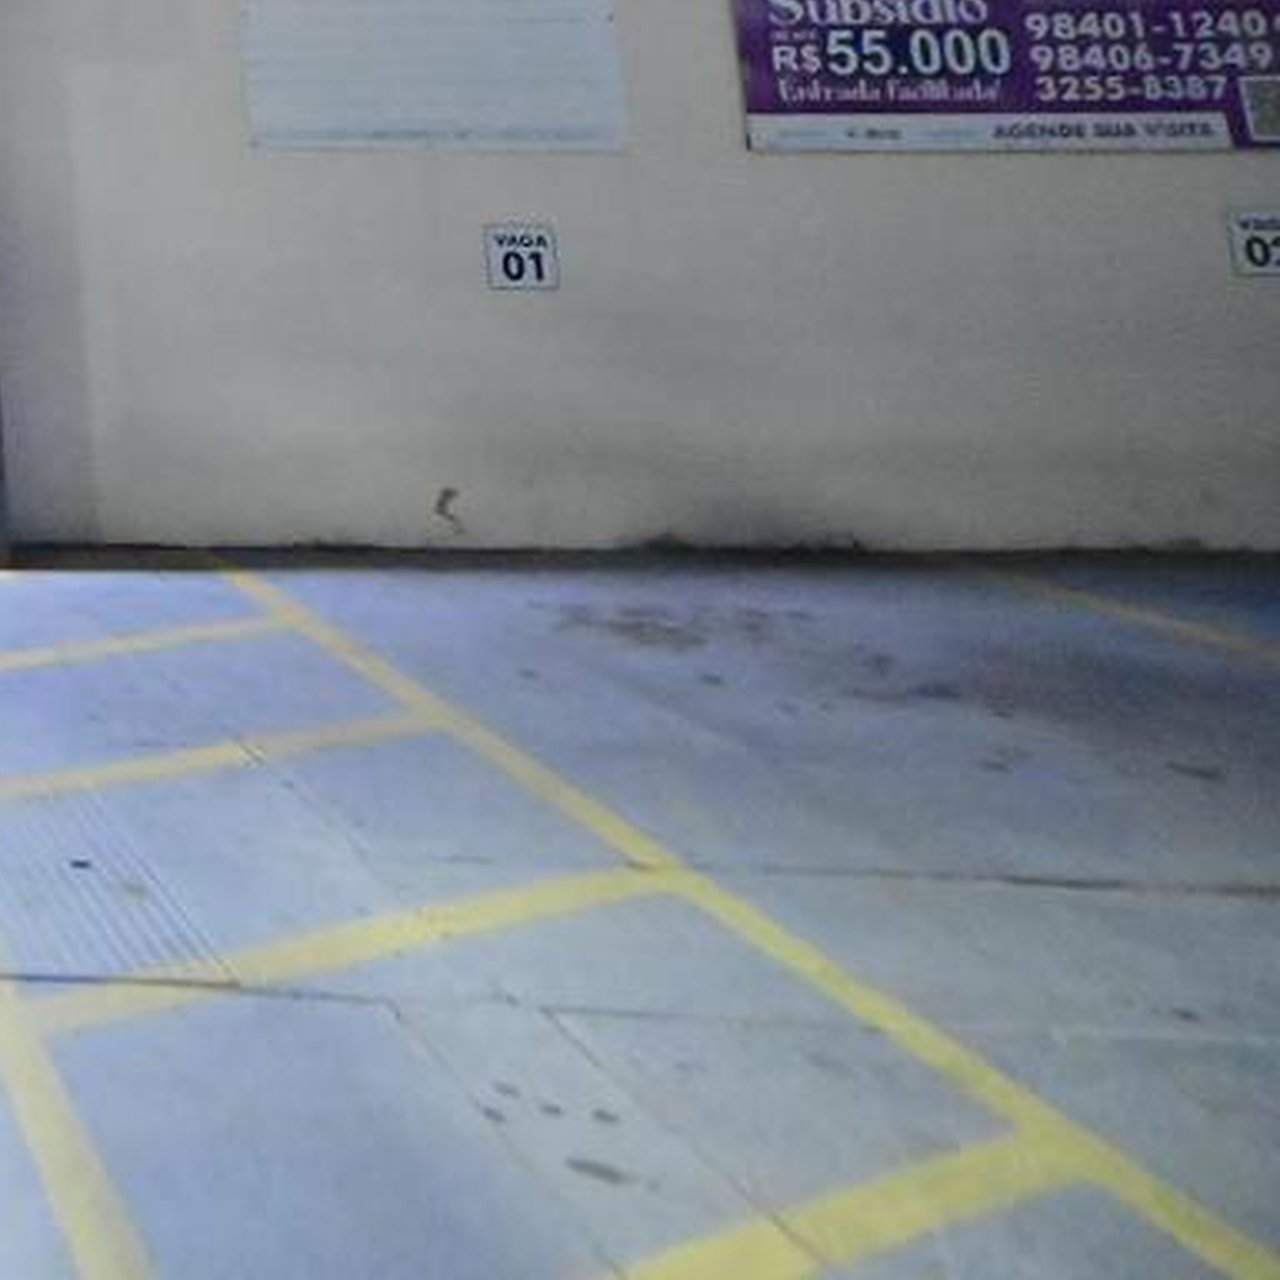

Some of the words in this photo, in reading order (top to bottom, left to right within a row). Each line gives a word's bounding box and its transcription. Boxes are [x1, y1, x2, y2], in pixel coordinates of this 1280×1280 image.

[1024, 10, 1267, 41] 98401-1240
[1029, 41, 1274, 72] 98406-7349
[1036, 74, 1228, 102] 3255-8387
[503, 250, 545, 282] 01
